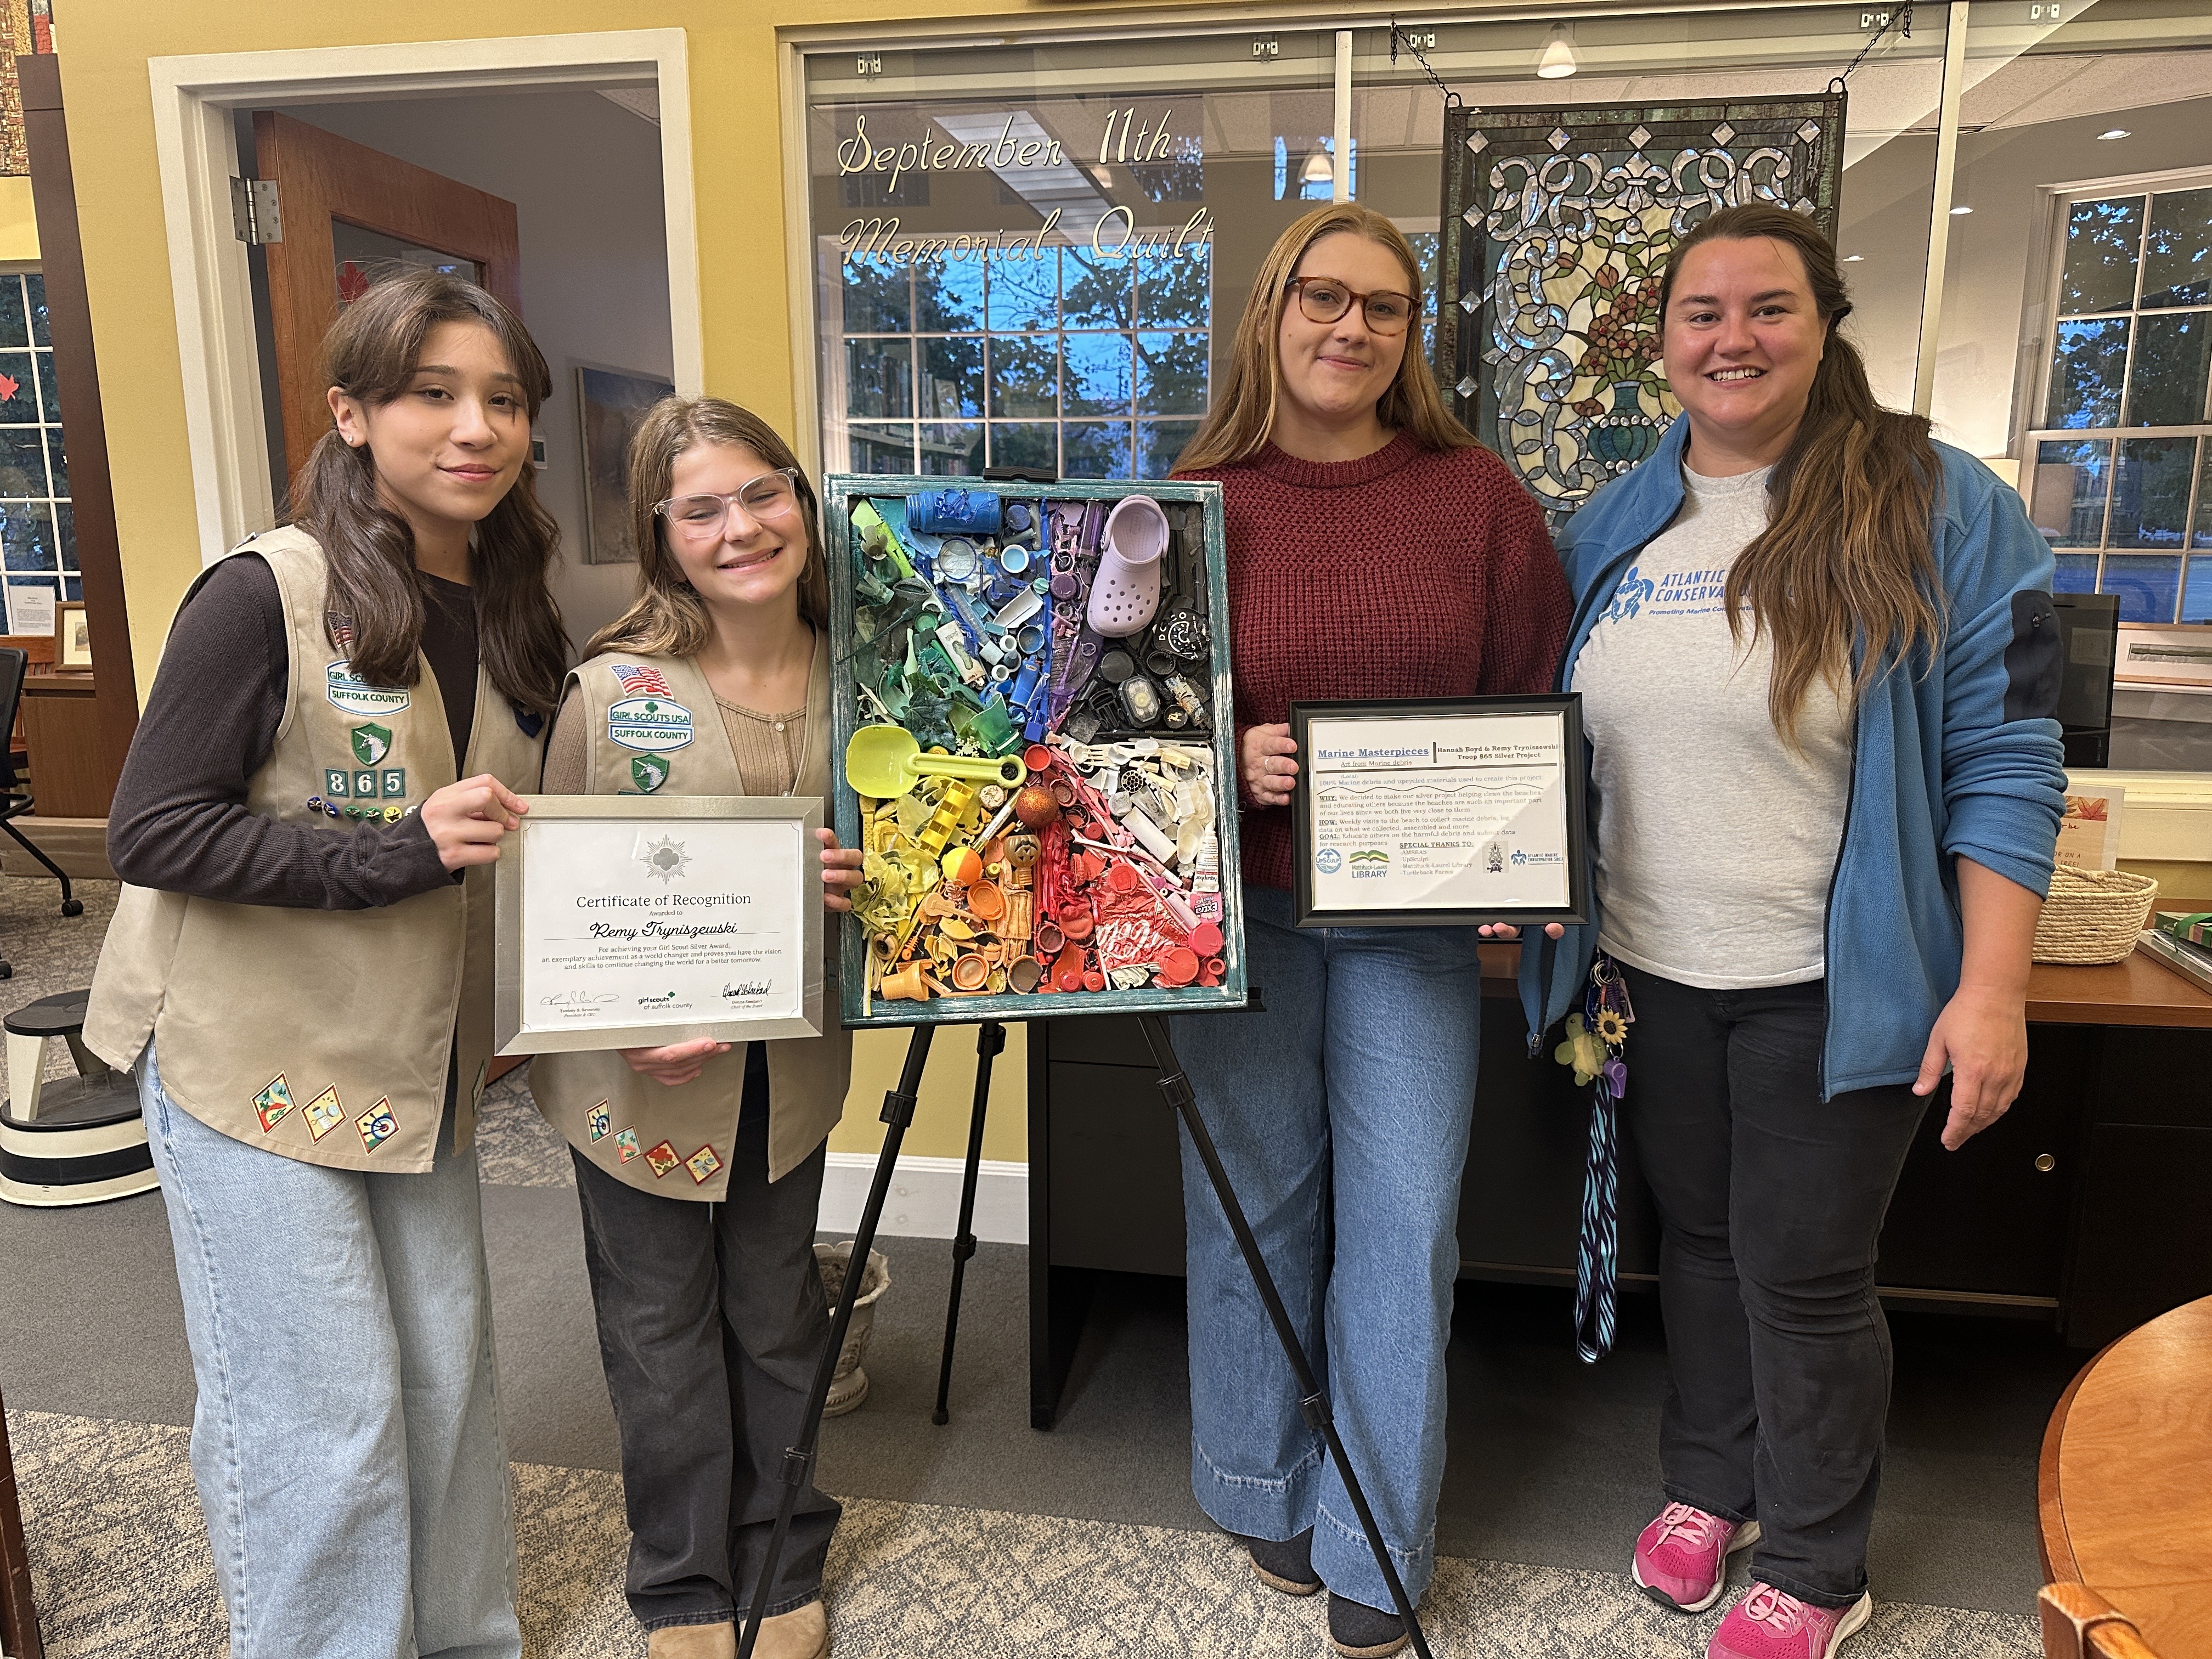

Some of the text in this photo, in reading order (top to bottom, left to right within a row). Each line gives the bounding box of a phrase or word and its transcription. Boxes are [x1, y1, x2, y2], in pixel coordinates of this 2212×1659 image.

[838, 107, 1172, 193] September 11th
[840, 206, 1214, 265] Memorial Quilt
[1660, 569, 1726, 587] ATLANTIC
[1655, 585, 1725, 602] CONSERVA
[330, 671, 348, 681] GIRL
[332, 690, 404, 703] SUFFOLK COUNTY
[613, 711, 689, 723] GIRL SCOUTS USA
[654, 731, 688, 740] COUNTY
[1318, 748, 1429, 758] Marine Masterpieces
[577, 893, 751, 907] Certificate of Recognition
[590, 921, 737, 941] Remy Tryniszewski
